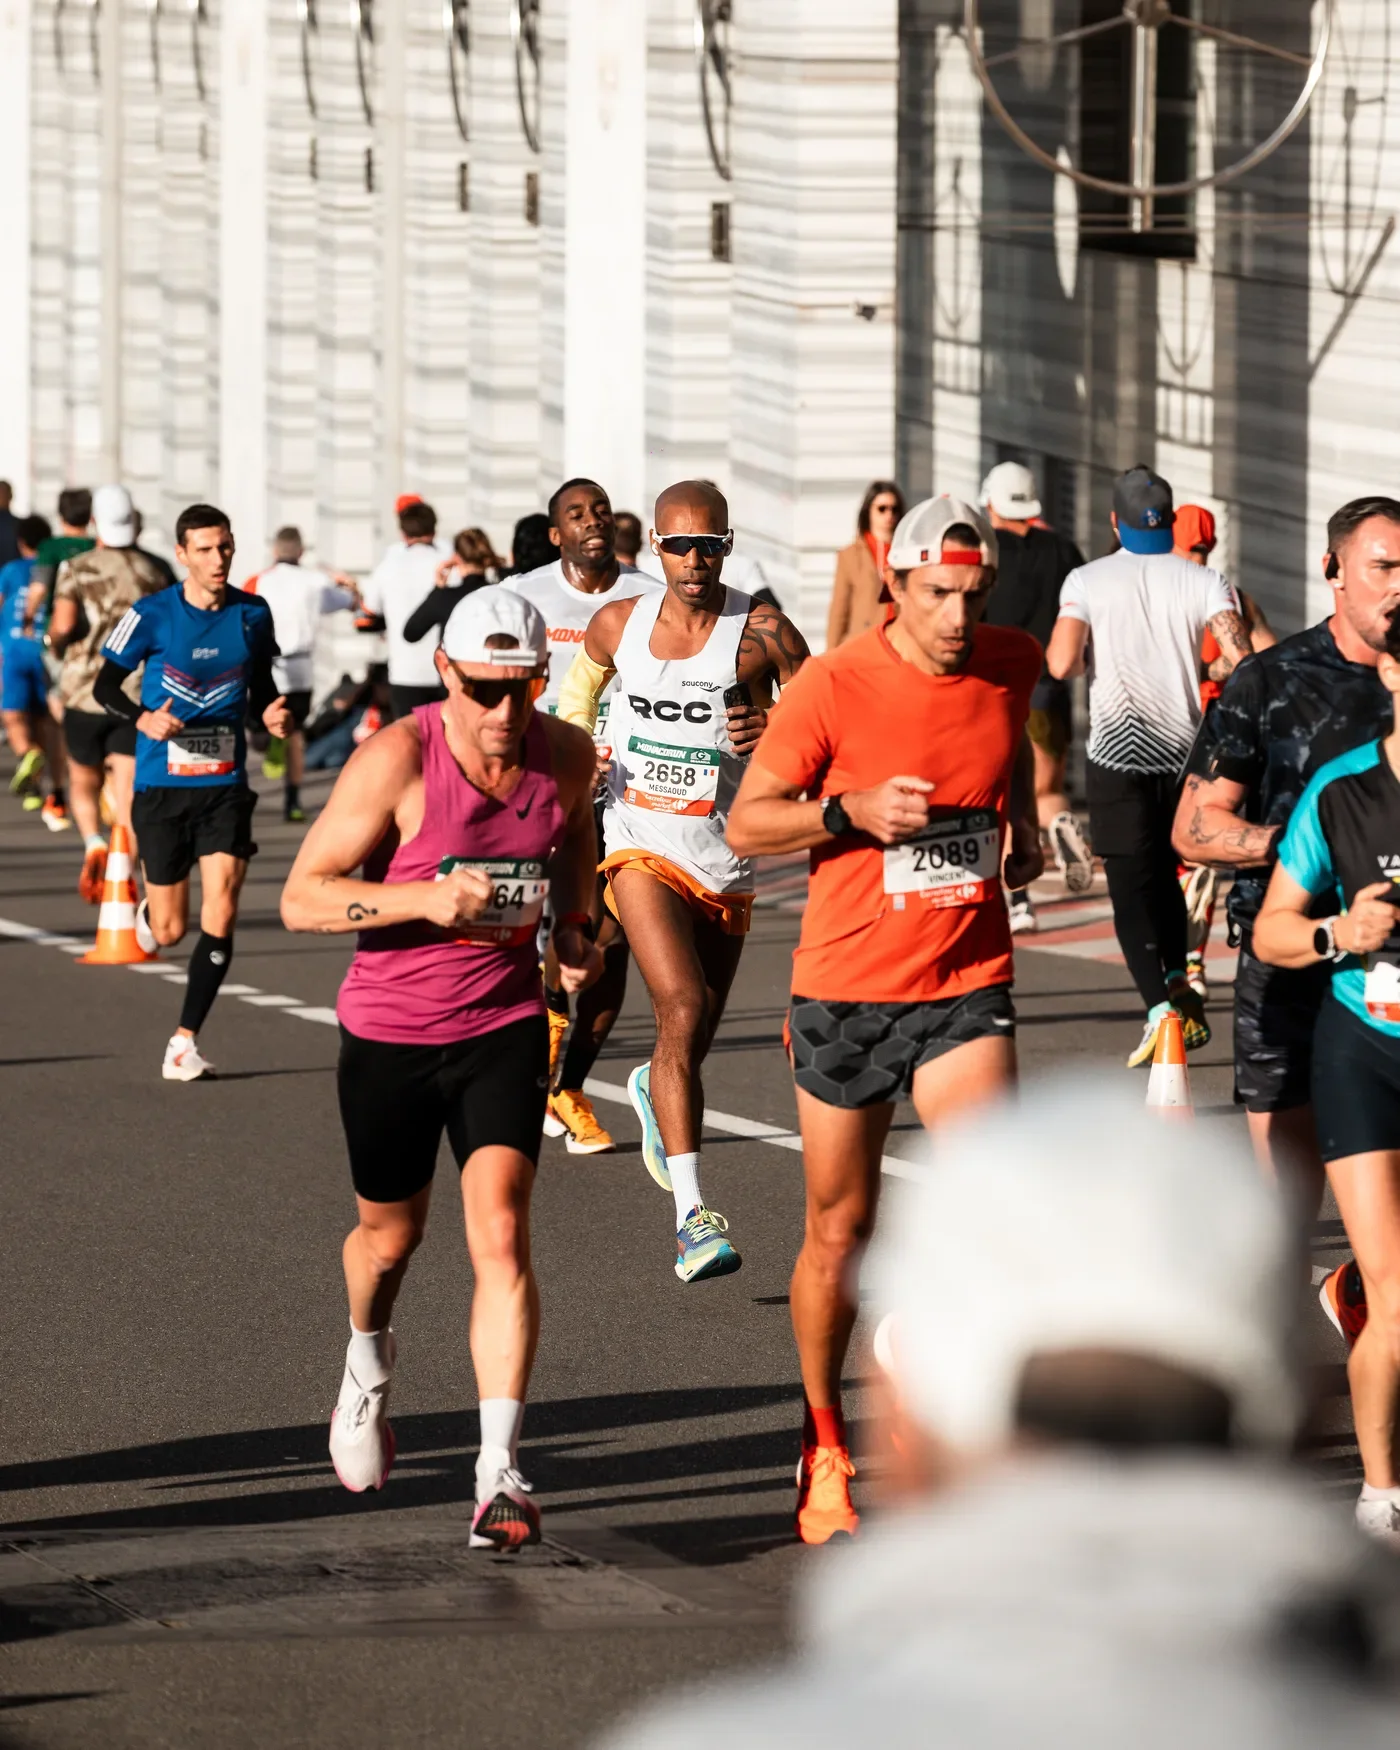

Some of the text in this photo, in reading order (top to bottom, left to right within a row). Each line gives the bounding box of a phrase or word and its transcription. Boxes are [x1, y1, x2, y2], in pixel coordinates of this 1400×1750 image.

[681, 680, 713, 688] saucony
[628, 694, 713, 724] RCC
[593, 720, 607, 736] 7
[187, 739, 221, 754] 2125
[643, 760, 696, 787] 2658
[648, 783, 687, 797] MESSAOUD
[912, 838, 979, 871] 2089
[928, 870, 966, 884] VINCENT
[487, 884, 525, 911] 64
